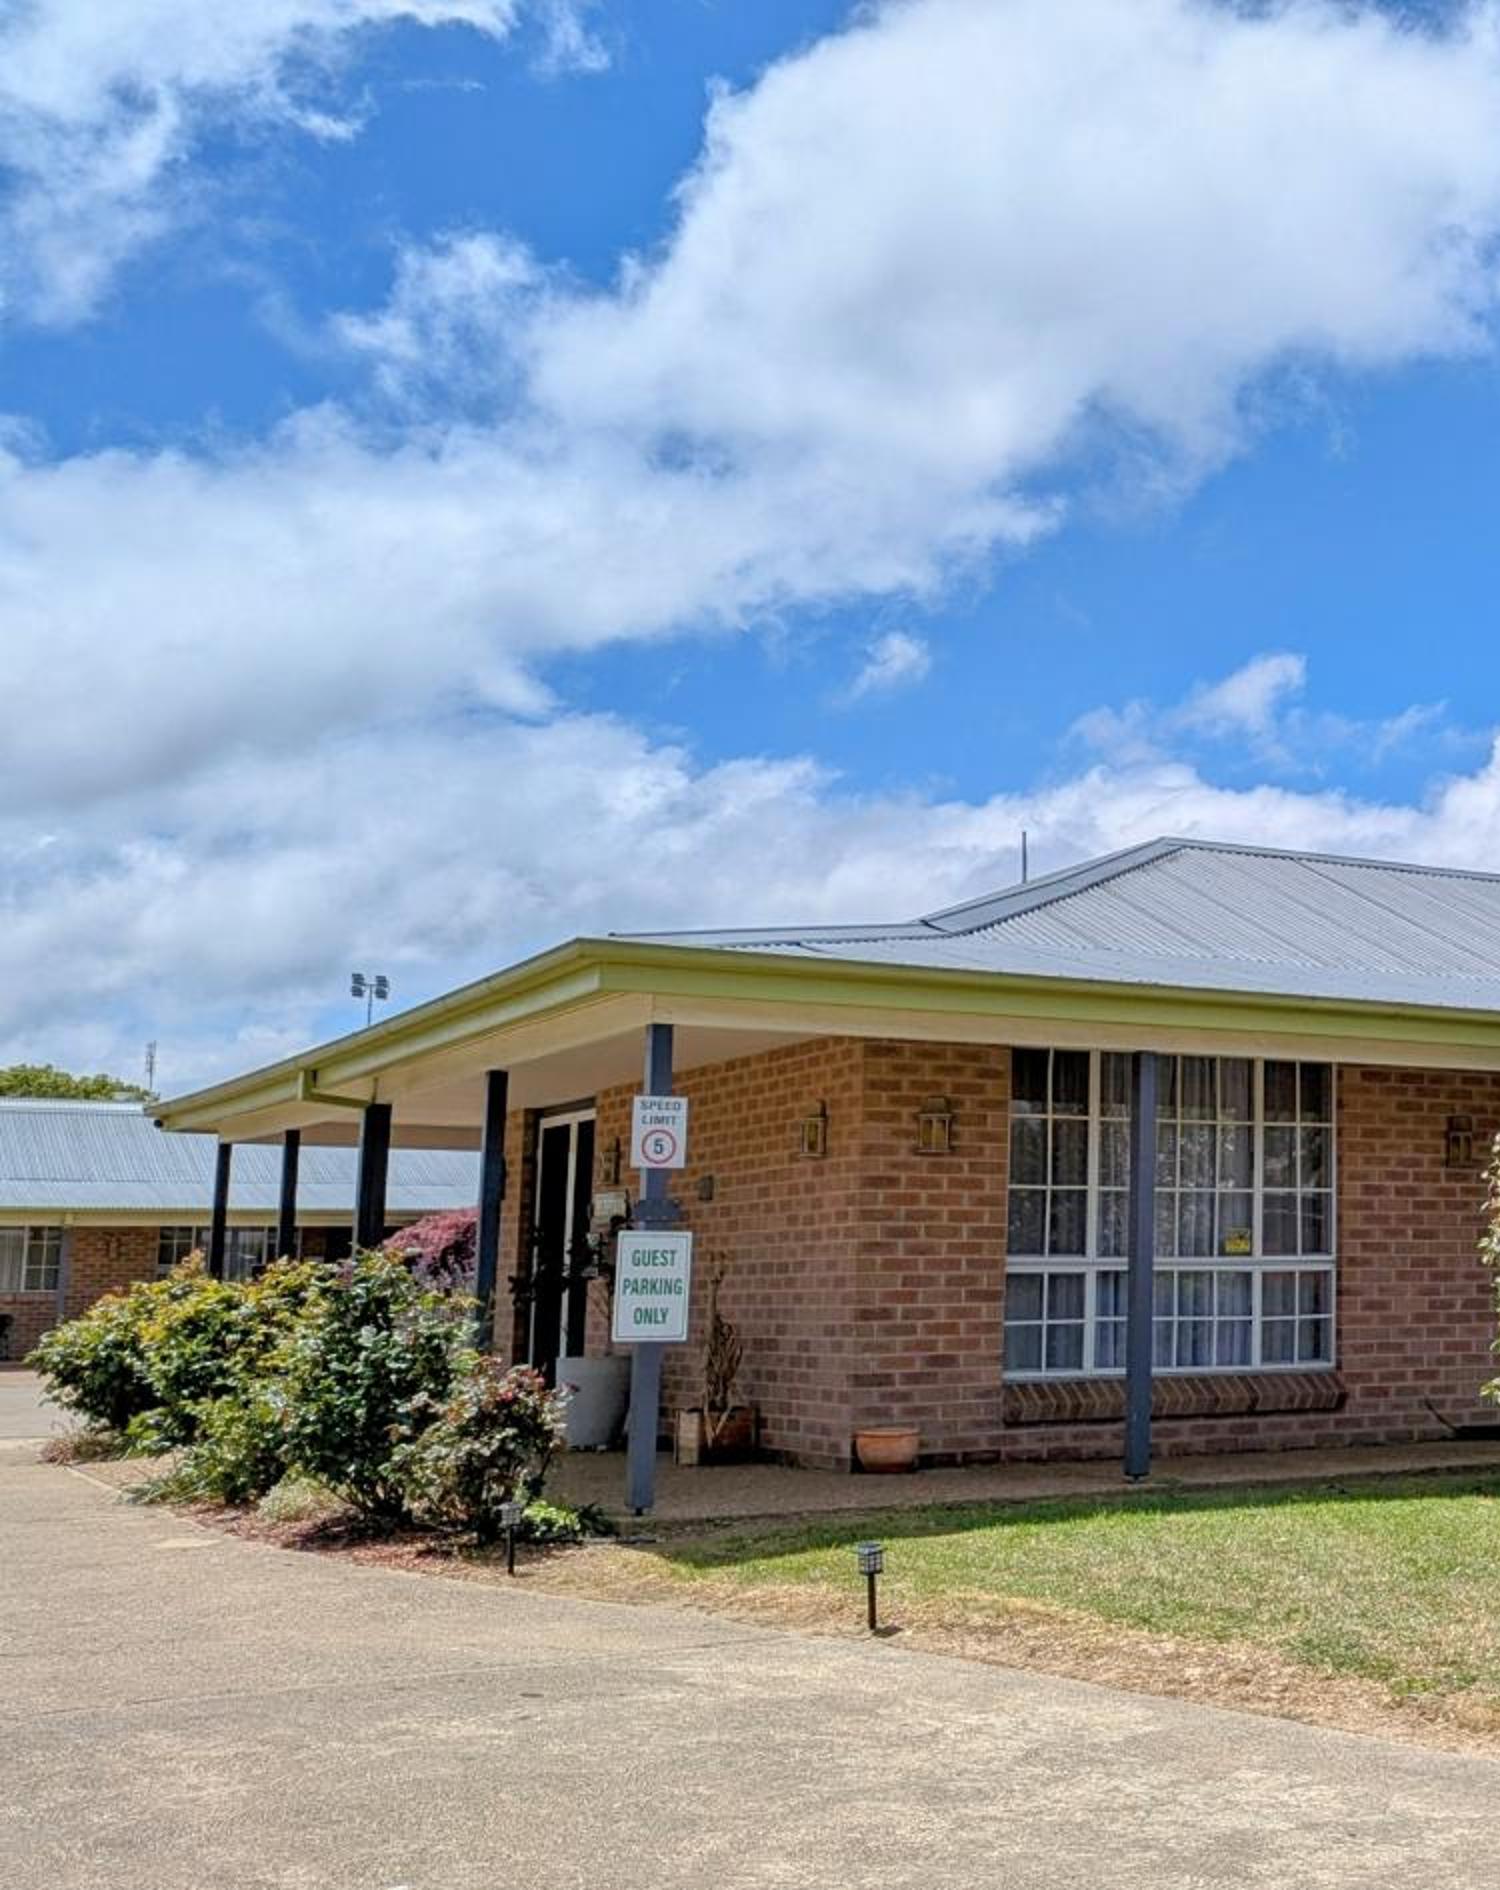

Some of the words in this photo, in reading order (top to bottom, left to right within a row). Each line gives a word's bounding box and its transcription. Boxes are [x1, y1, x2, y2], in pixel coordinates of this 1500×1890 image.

[640, 1100, 681, 1112] SPEED
[641, 1114, 677, 1125] LIMIT
[653, 1138, 664, 1154] 5
[631, 1249, 677, 1267] GUEST
[622, 1277, 683, 1296] PARKING
[633, 1306, 669, 1325] ONLY
